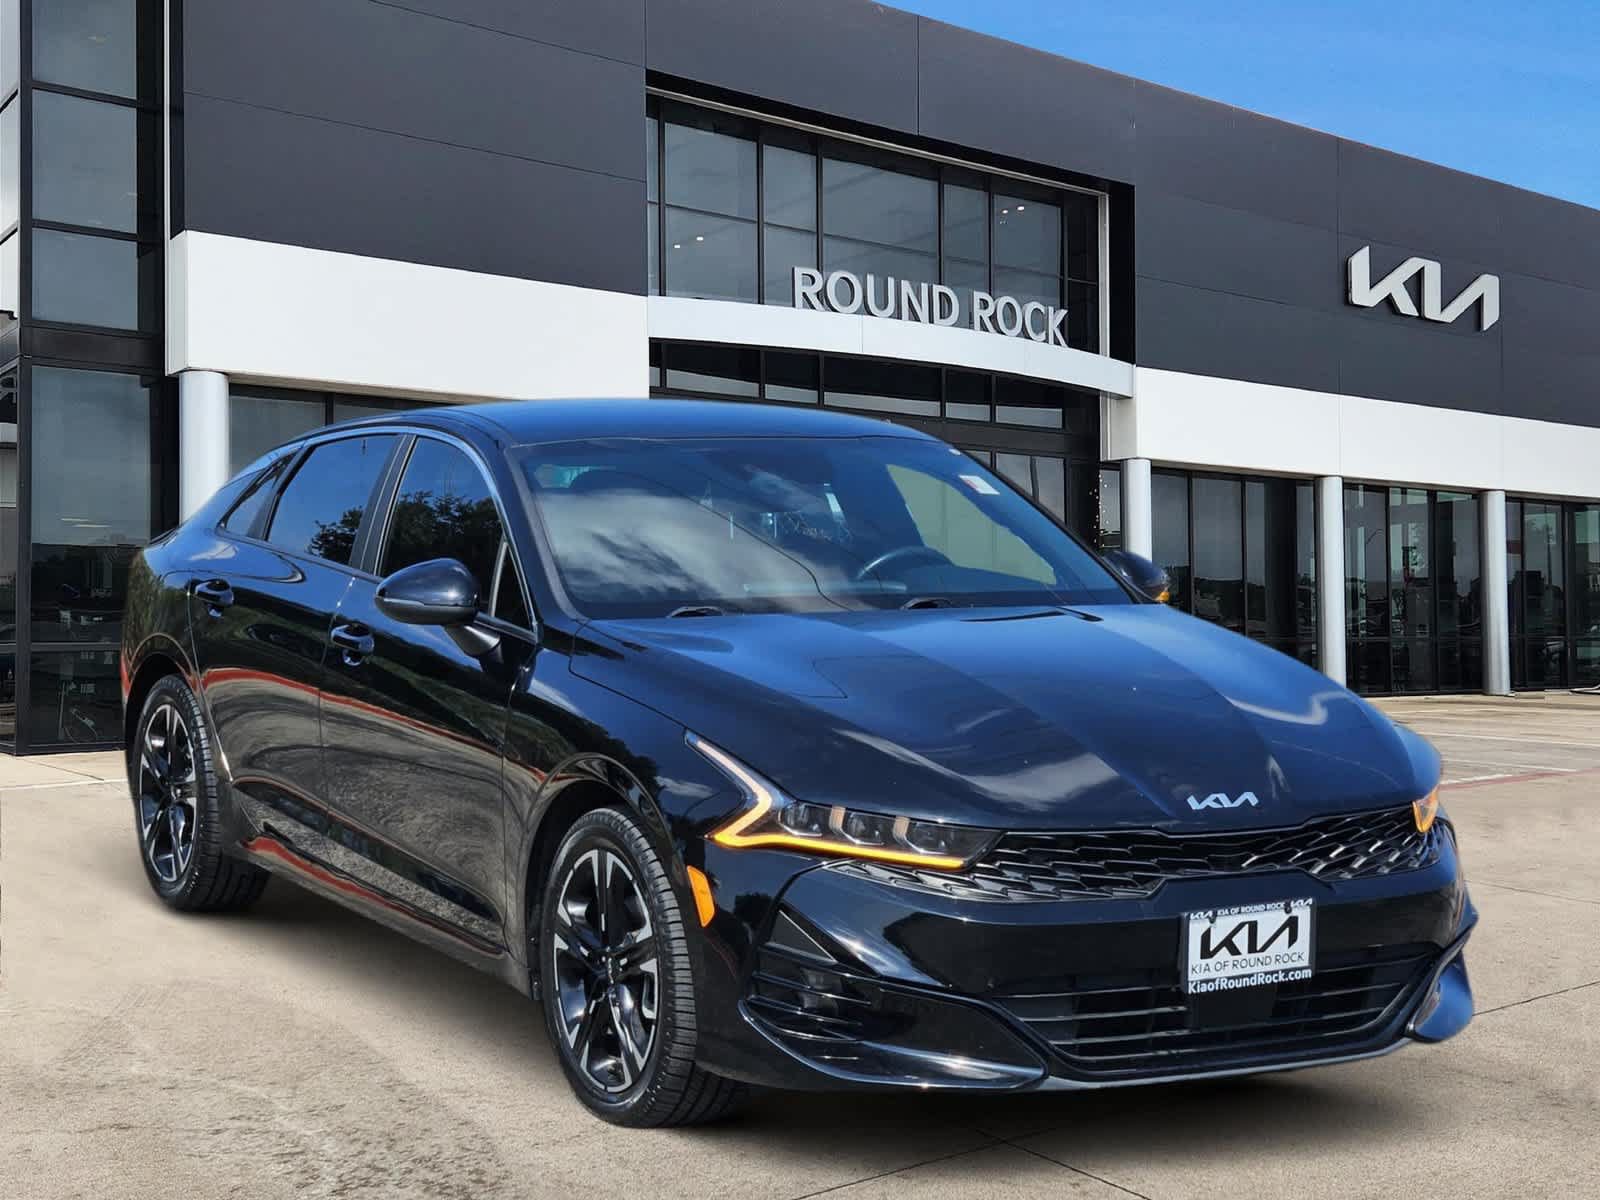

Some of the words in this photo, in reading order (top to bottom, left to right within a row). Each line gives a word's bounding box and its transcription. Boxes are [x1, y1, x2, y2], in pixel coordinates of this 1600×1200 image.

[1348, 245, 1499, 331] KIA
[792, 266, 960, 327] ROUND
[971, 289, 1069, 348] ROCK
[1187, 792, 1258, 810] KIA
[1230, 906, 1240, 915] OF
[1241, 903, 1265, 913] ROUND
[1200, 916, 1299, 960] KIA
[1191, 963, 1211, 975] KIA
[1214, 960, 1230, 972] OF
[1232, 955, 1272, 969] ROUND
[1275, 952, 1304, 964] ROCK
[1188, 968, 1312, 994] KiaofRoundRock.com
